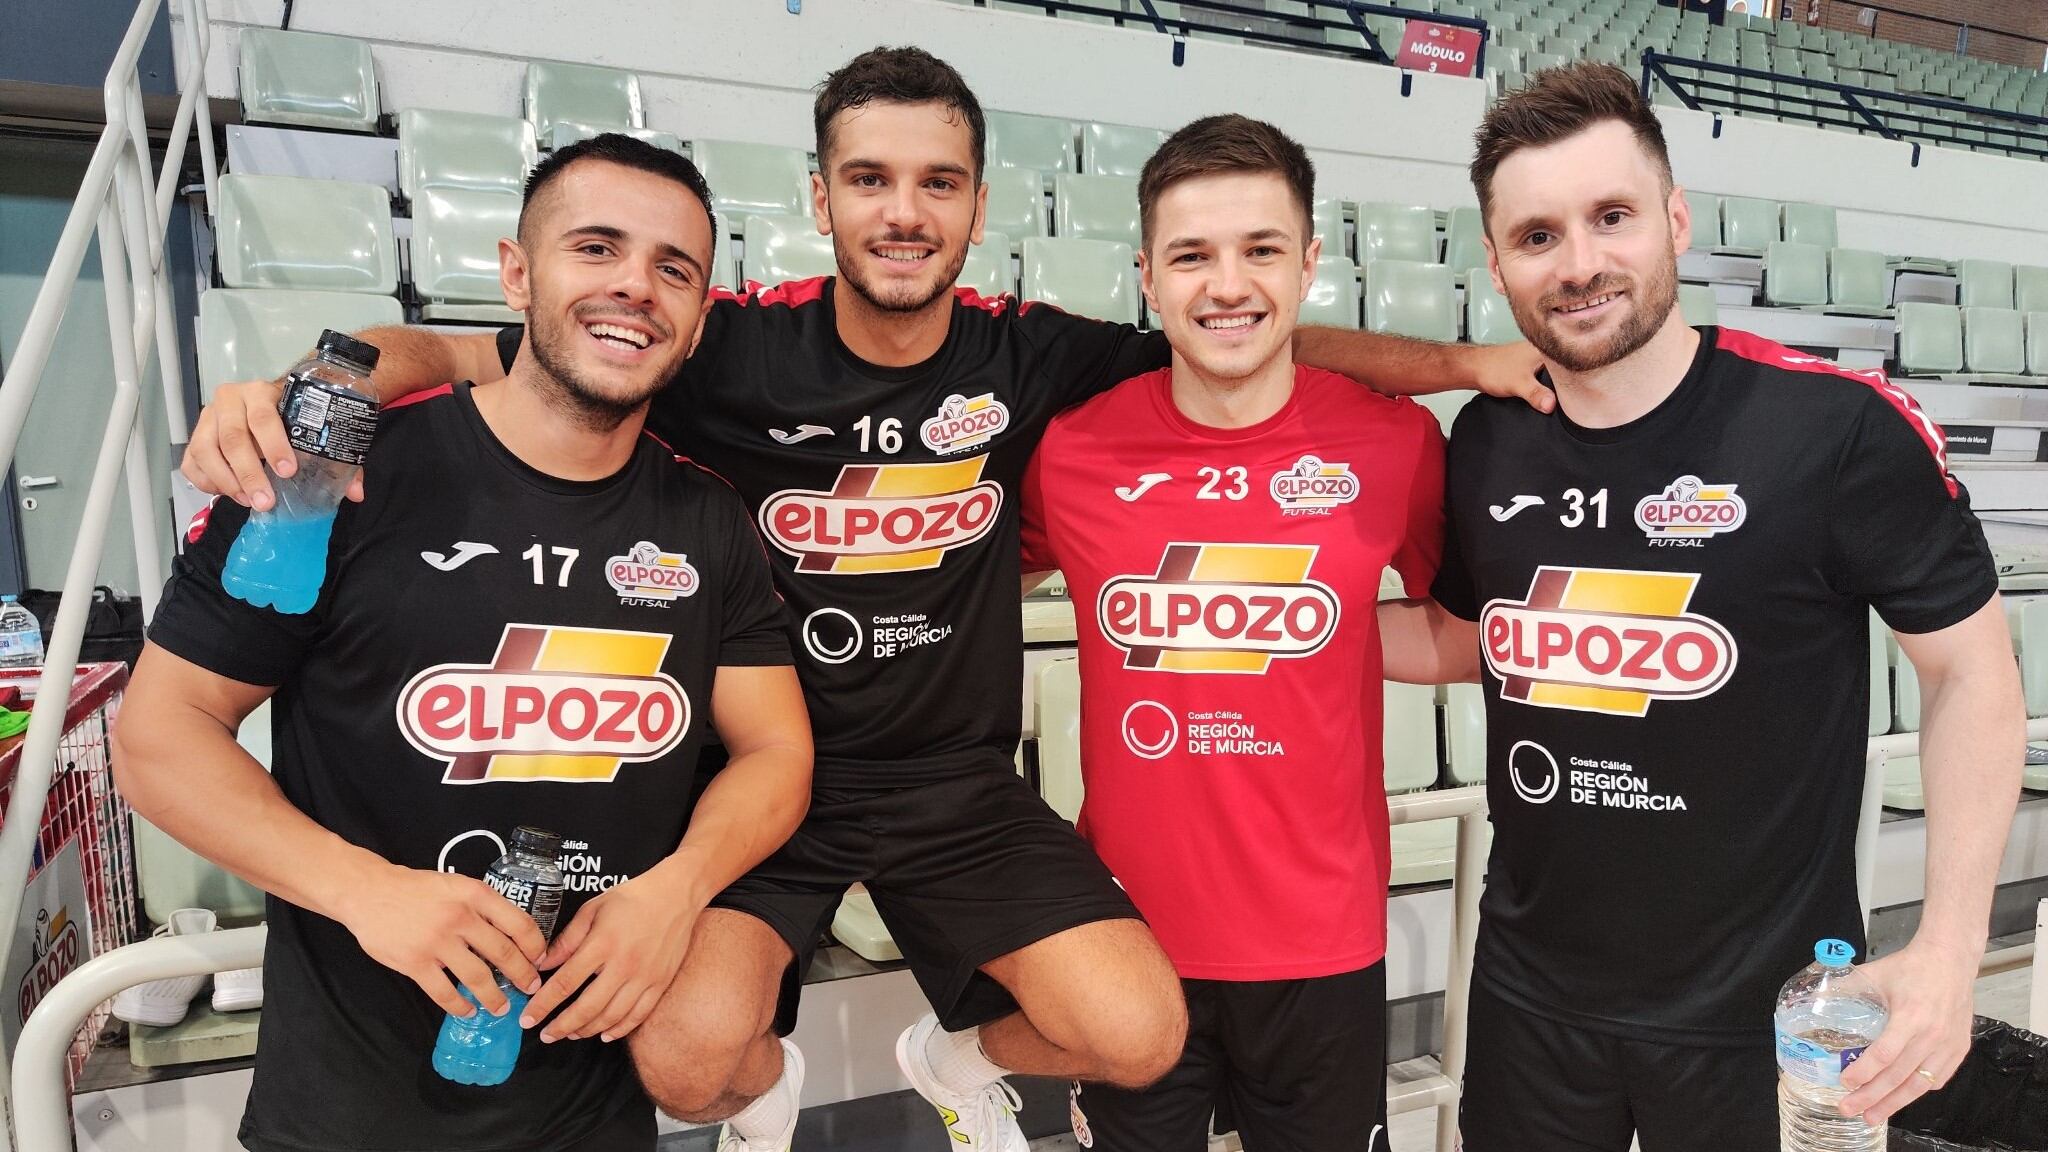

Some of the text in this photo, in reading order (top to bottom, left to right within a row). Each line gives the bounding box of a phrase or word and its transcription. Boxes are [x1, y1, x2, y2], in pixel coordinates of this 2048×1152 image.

[1410, 41, 1465, 62] MÓDULO
[1428, 61, 1438, 73] 3
[853, 415, 903, 454] 16
[1196, 465, 1249, 501] 23
[1282, 507, 1332, 517] FUTSAL
[1559, 488, 1608, 529] 31
[1648, 538, 1705, 548] FUTSAL
[522, 543, 580, 588] 17
[620, 597, 671, 609] FUTSAL
[872, 613, 927, 624] Costa Cálida
[873, 643, 897, 658] DE
[1188, 710, 1243, 720] Costa Cálida
[1188, 722, 1255, 739] REGIÓN
[1188, 739, 1285, 756] DE MURCIA
[1570, 756, 1633, 772] Costa Cálida
[1570, 770, 1648, 793] REGIÓN
[1570, 787, 1687, 811] DE MURCIA
[561, 839, 588, 850] álida
